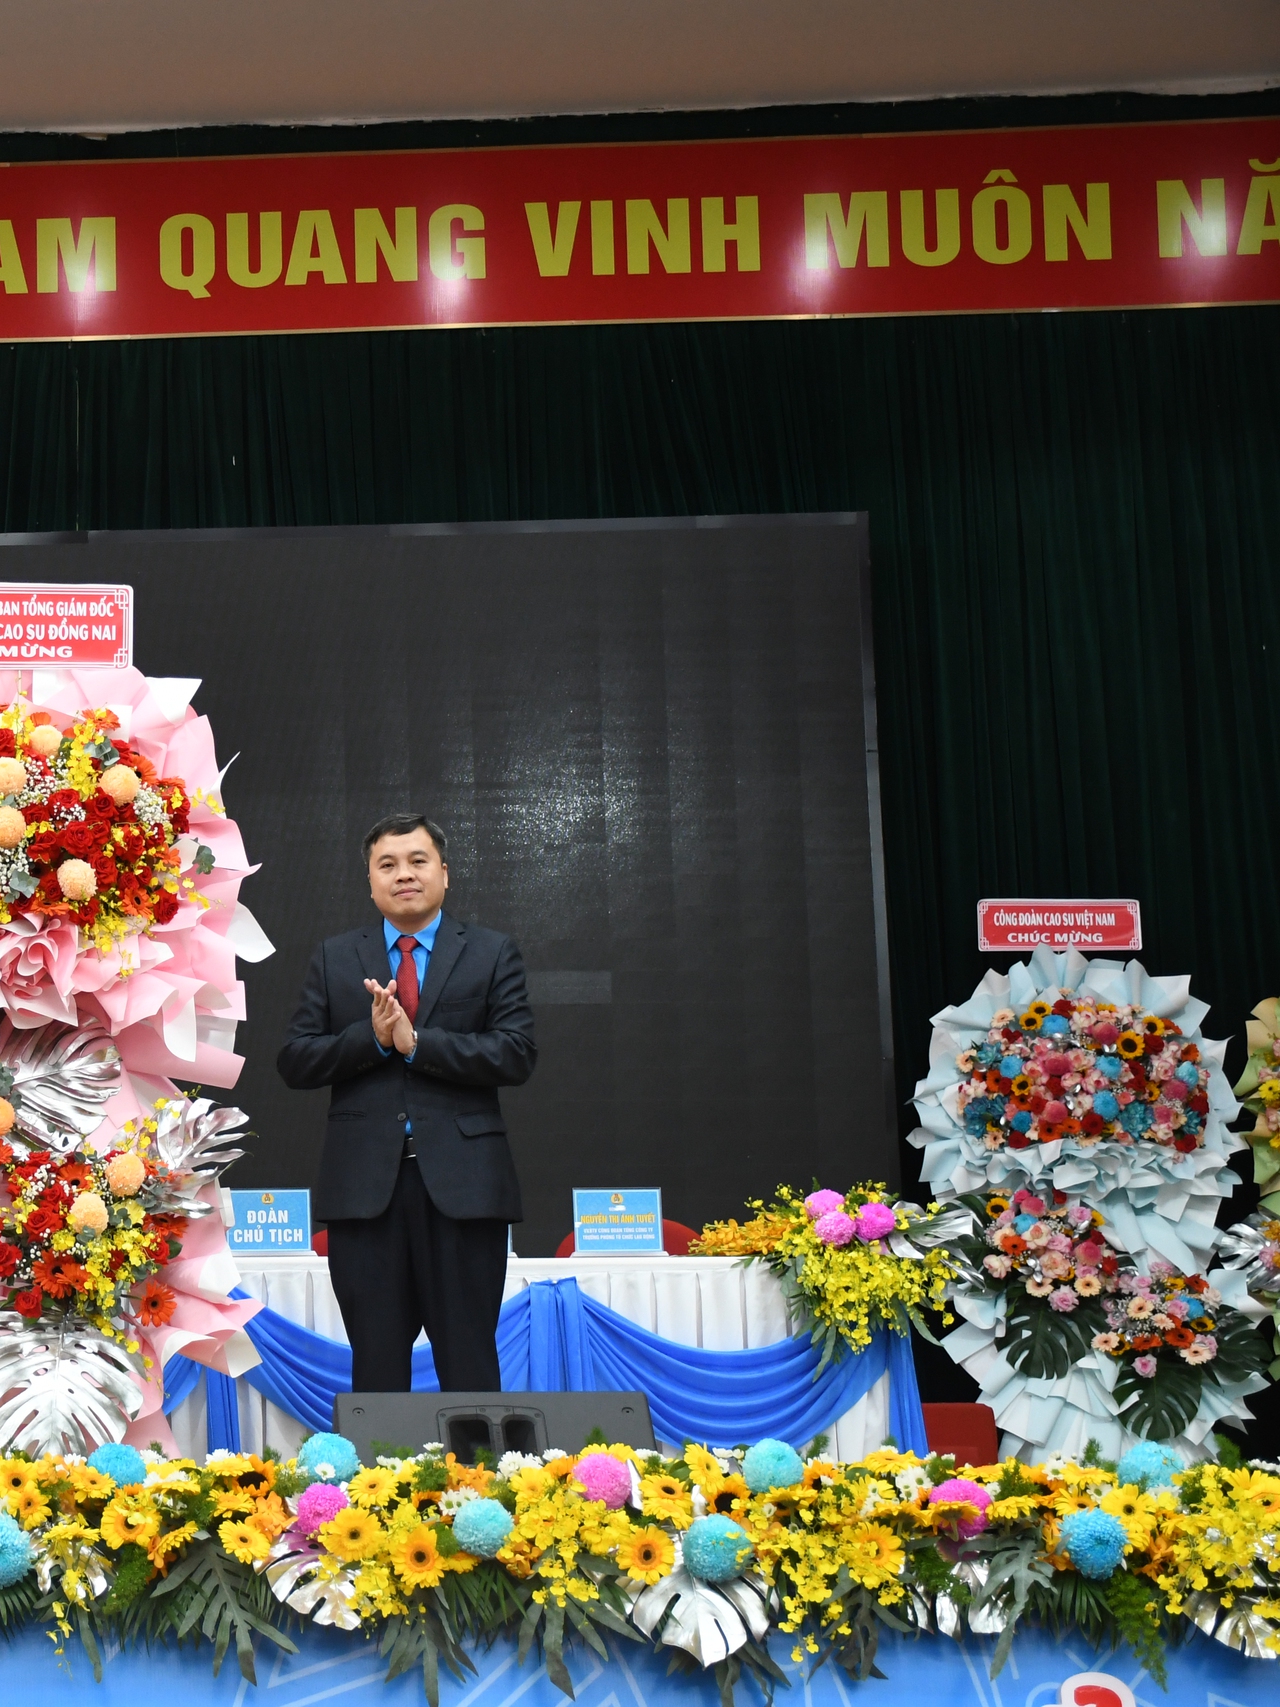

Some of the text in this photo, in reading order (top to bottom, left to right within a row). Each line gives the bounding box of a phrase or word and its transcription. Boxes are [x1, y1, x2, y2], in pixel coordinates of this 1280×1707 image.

[158, 203, 487, 299] QUANG
[524, 194, 761, 278] VINH
[803, 168, 1113, 270] MUÔN
[22, 593, 54, 616] TỔNG
[56, 597, 87, 616] GIÁM
[89, 595, 114, 617] ĐỐC
[26, 623, 45, 640] SU
[48, 617, 88, 640] ĐỒNG
[92, 624, 116, 640] NAI
[994, 909, 1115, 929] CÔNG ĐOÀN CAO SU VIỆT NAM
[1007, 930, 1103, 943] CHÚC MỪNG
[247, 1208, 288, 1223] ĐOÀN
[233, 1225, 303, 1245] CHỦ TỊCH
